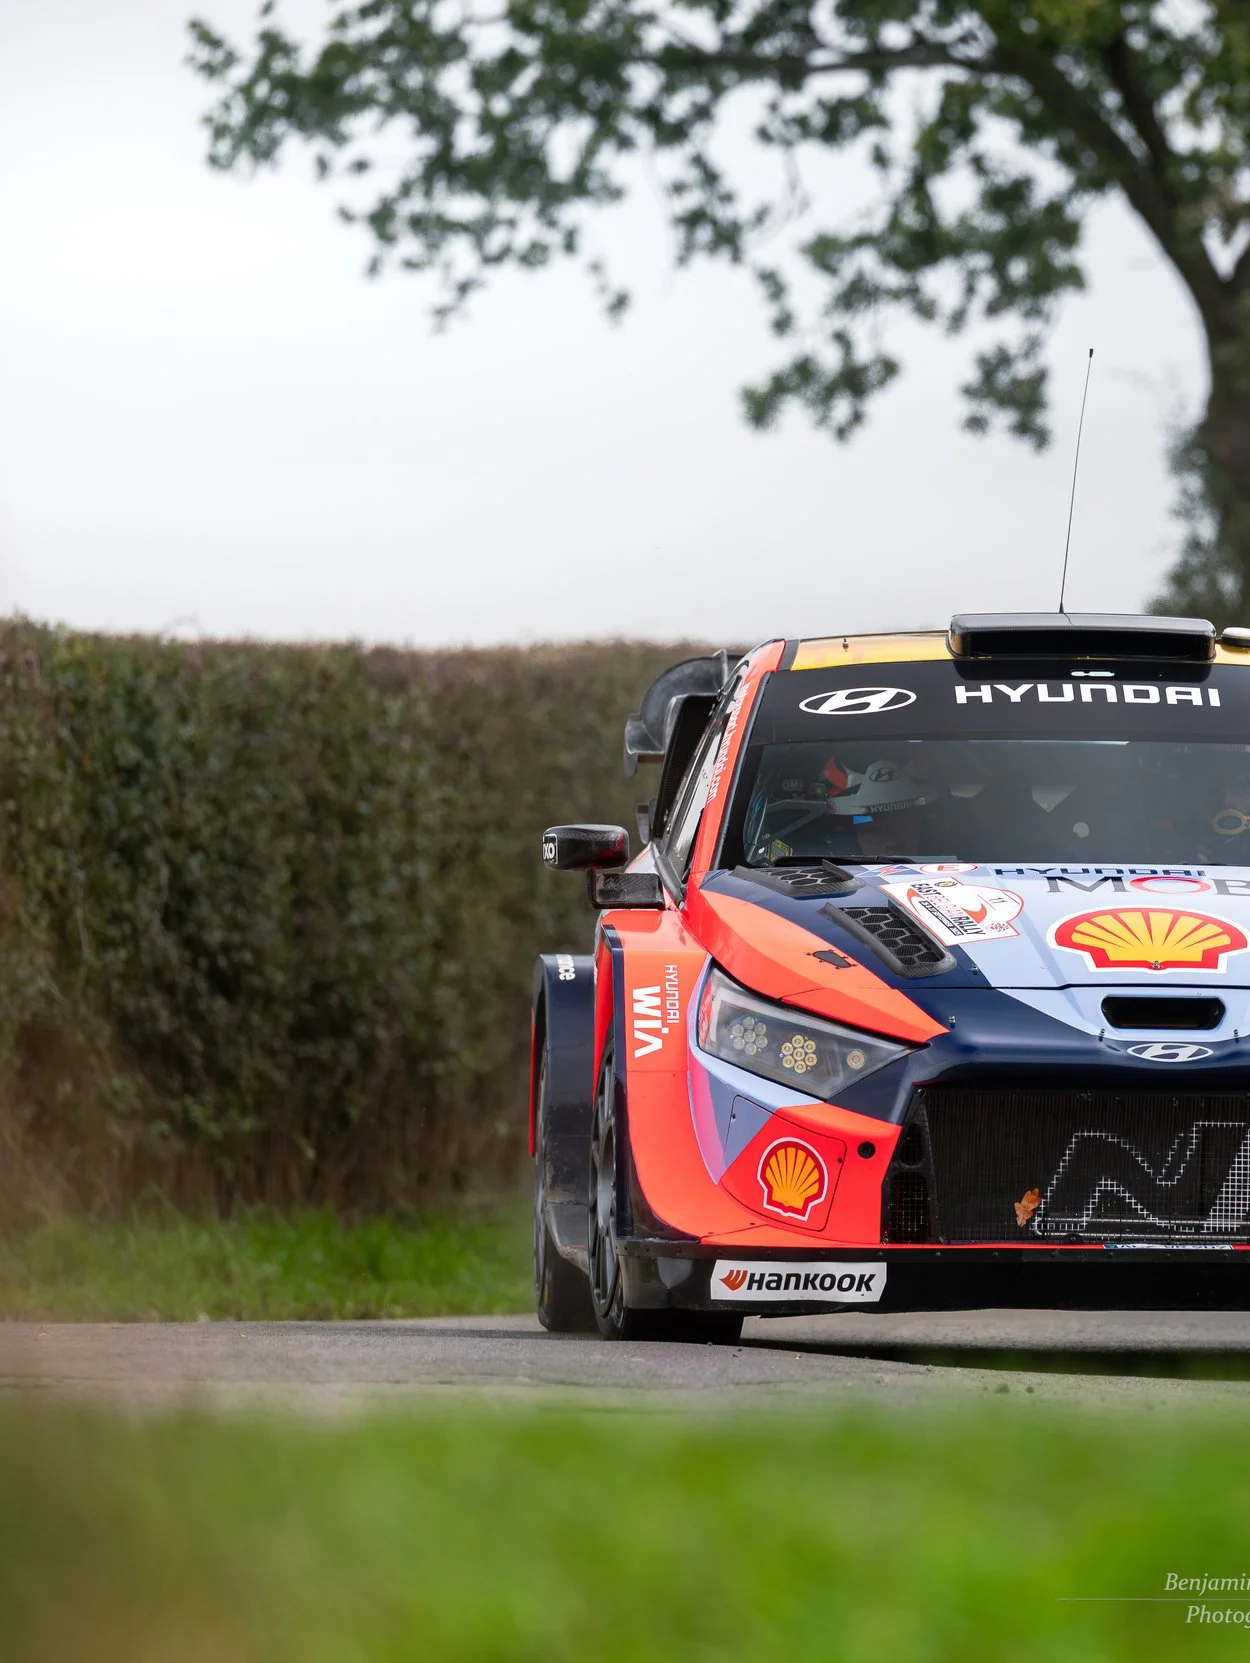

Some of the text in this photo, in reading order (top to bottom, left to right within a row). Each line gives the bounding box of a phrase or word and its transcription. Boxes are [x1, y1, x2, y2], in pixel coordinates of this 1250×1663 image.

[954, 684, 1221, 707] HYUNDAI
[995, 868, 1206, 876] HYUNDAI
[950, 916, 986, 935] RALLY
[664, 964, 680, 1024] HYUNDAI
